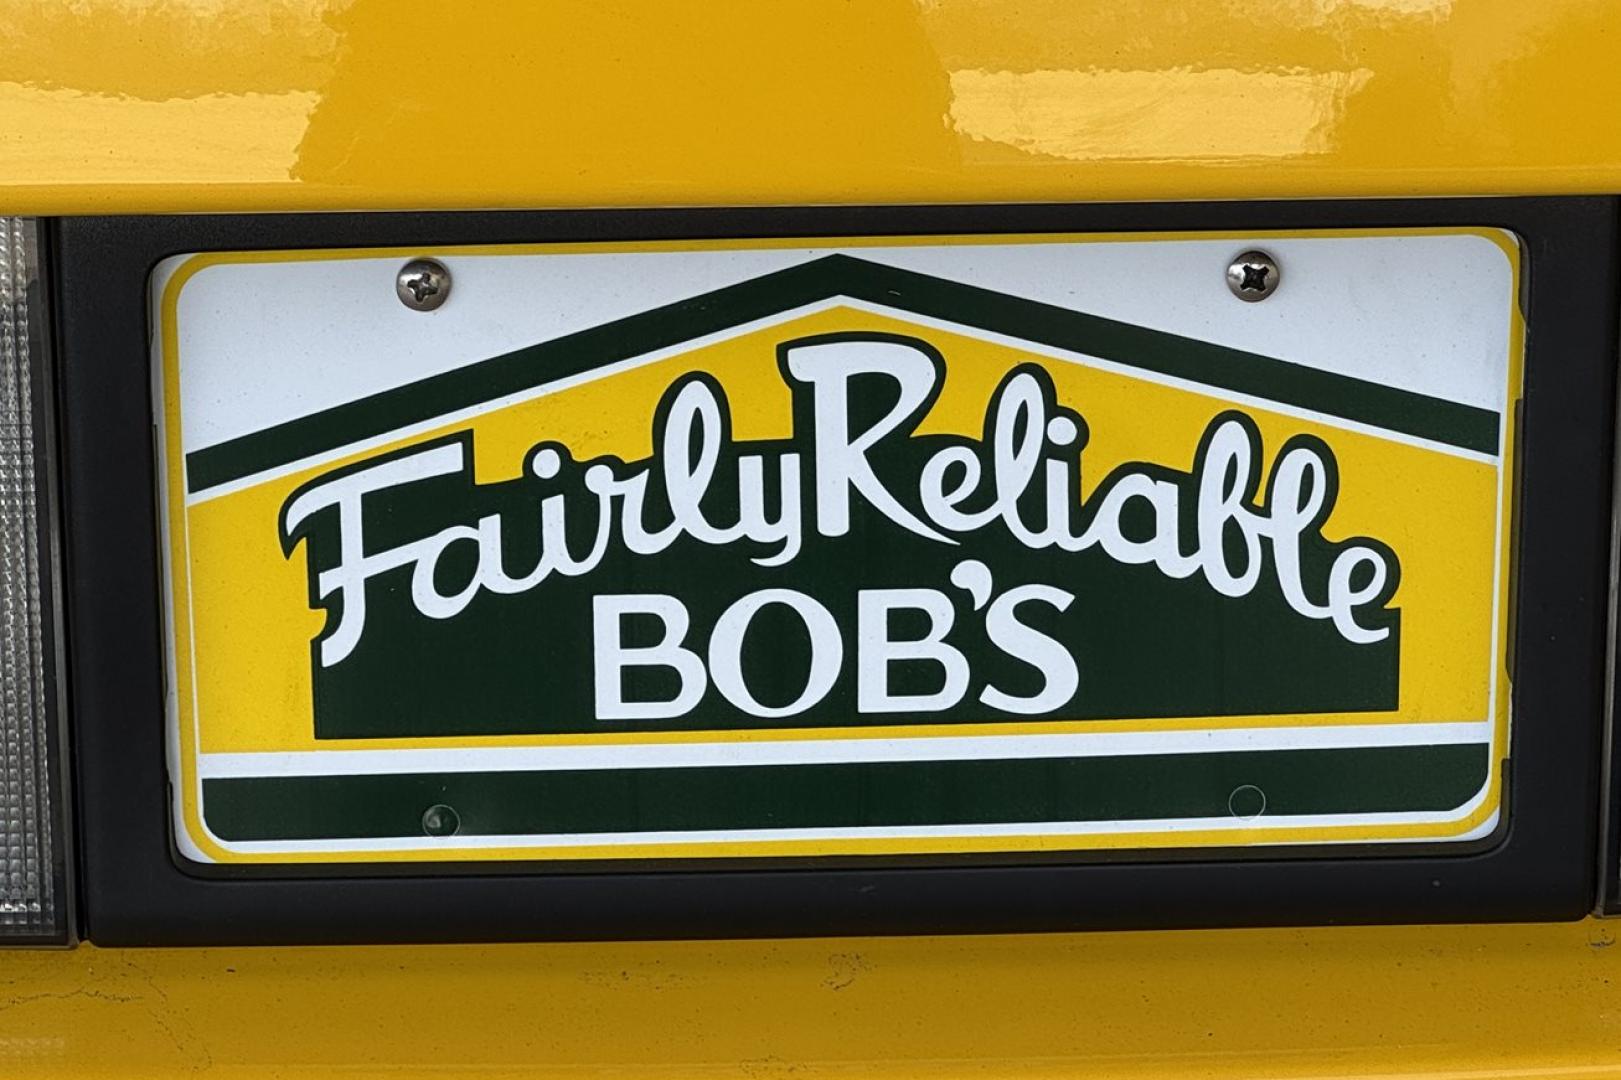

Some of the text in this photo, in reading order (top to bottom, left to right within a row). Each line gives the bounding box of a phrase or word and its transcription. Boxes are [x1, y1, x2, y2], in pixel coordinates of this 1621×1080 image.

[285, 340, 1391, 668] Fairly Reliable
[592, 559, 1080, 721] BOB'S
